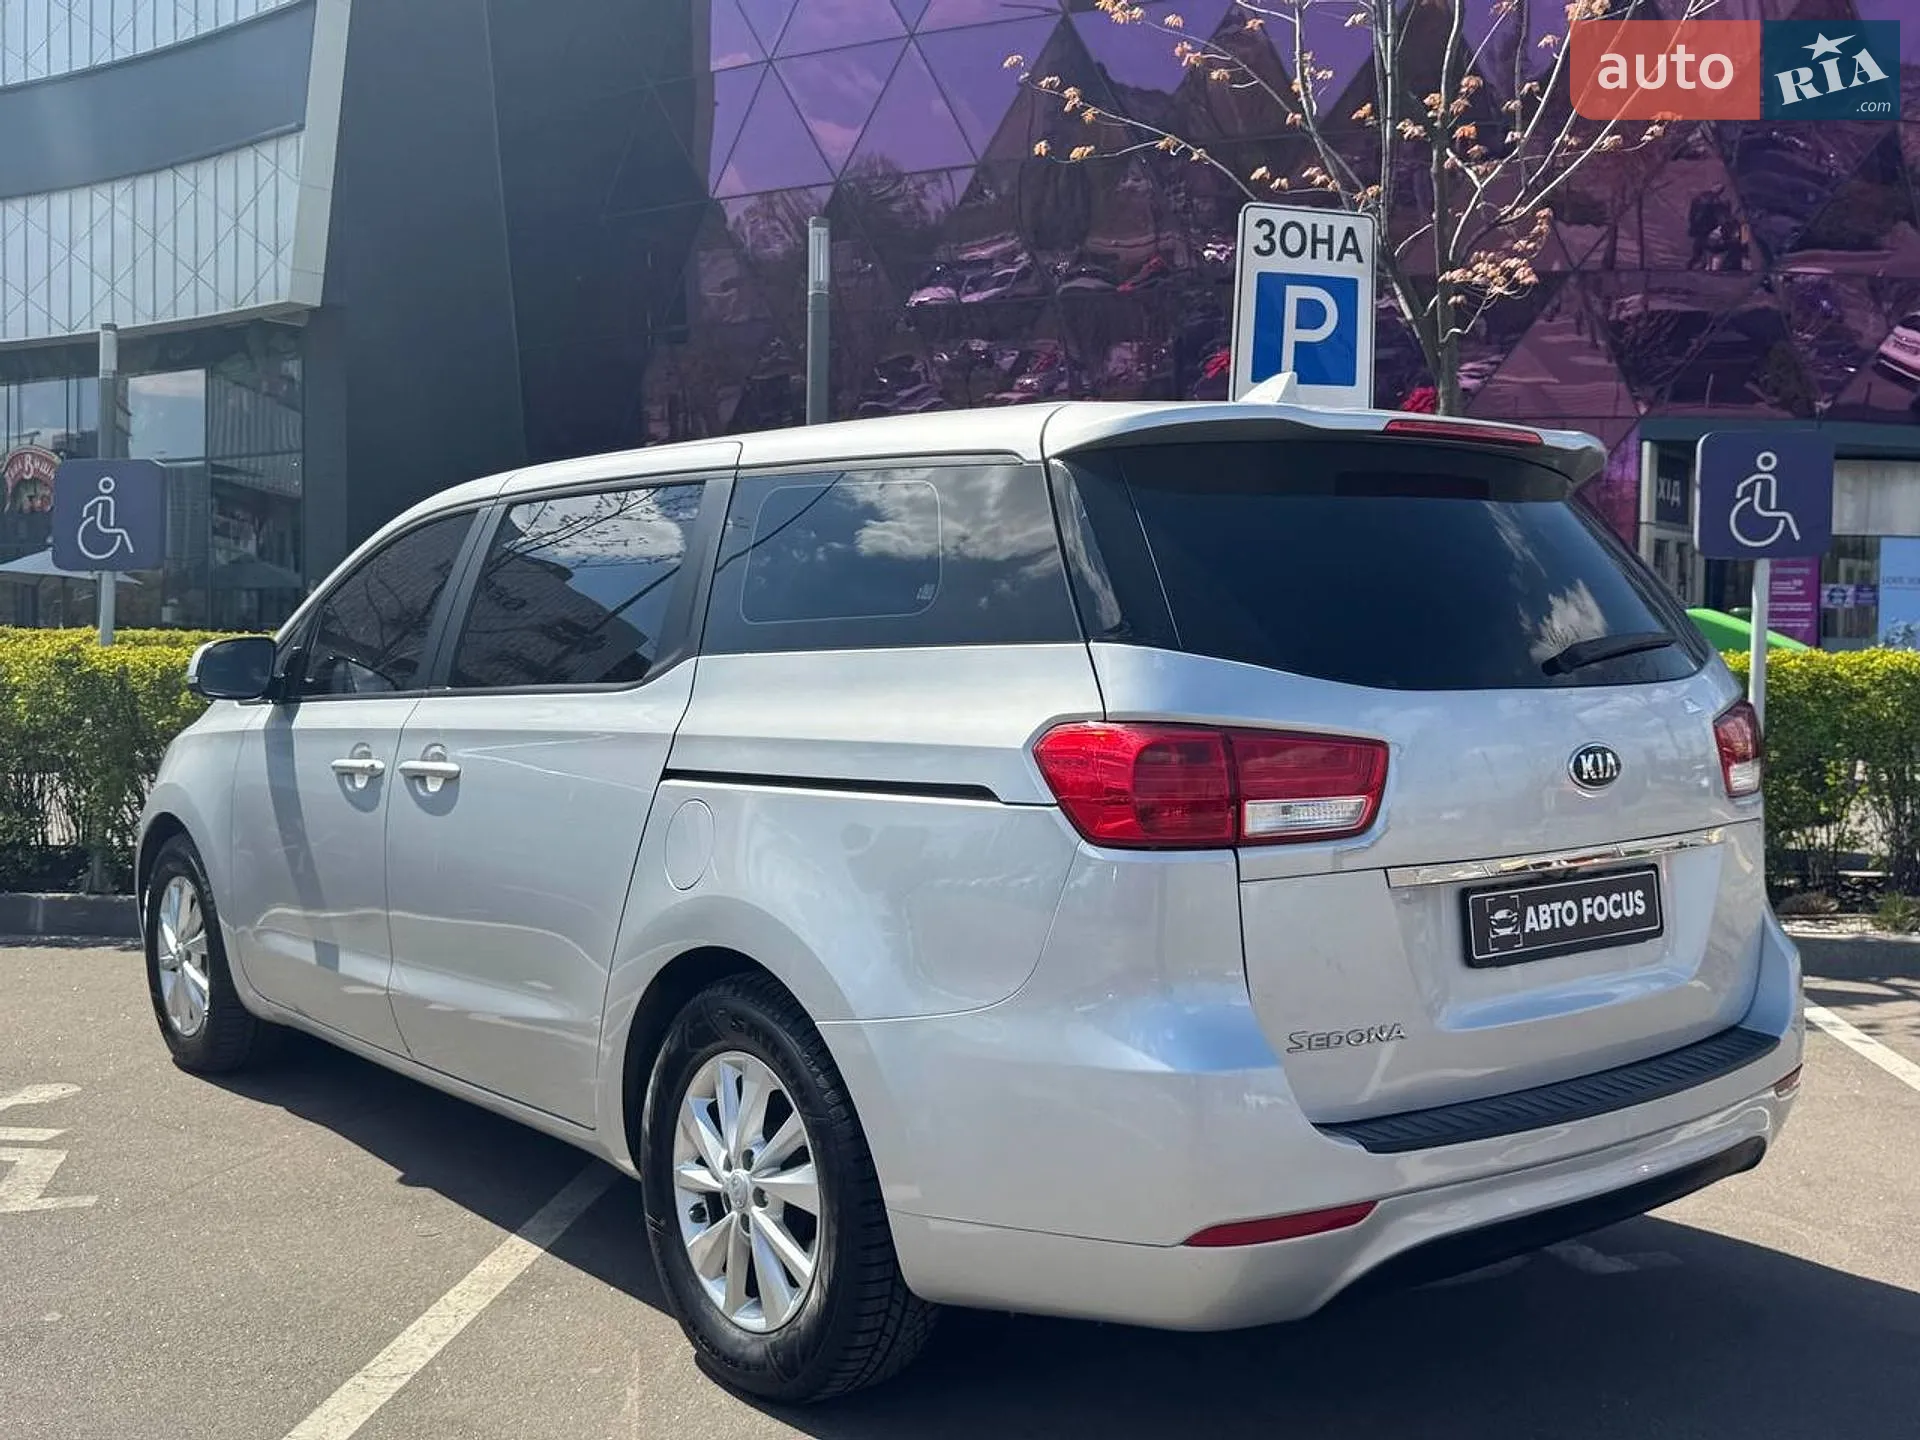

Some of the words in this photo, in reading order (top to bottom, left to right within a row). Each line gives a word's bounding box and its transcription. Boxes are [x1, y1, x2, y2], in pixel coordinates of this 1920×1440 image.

[1253, 218, 1364, 263] ЗОНА
[1281, 284, 1339, 373] P
[1579, 752, 1618, 779] KIA
[1525, 900, 1578, 933] АВТО
[1582, 890, 1646, 923] FOCUS
[1286, 1022, 1407, 1054] SEDONA
